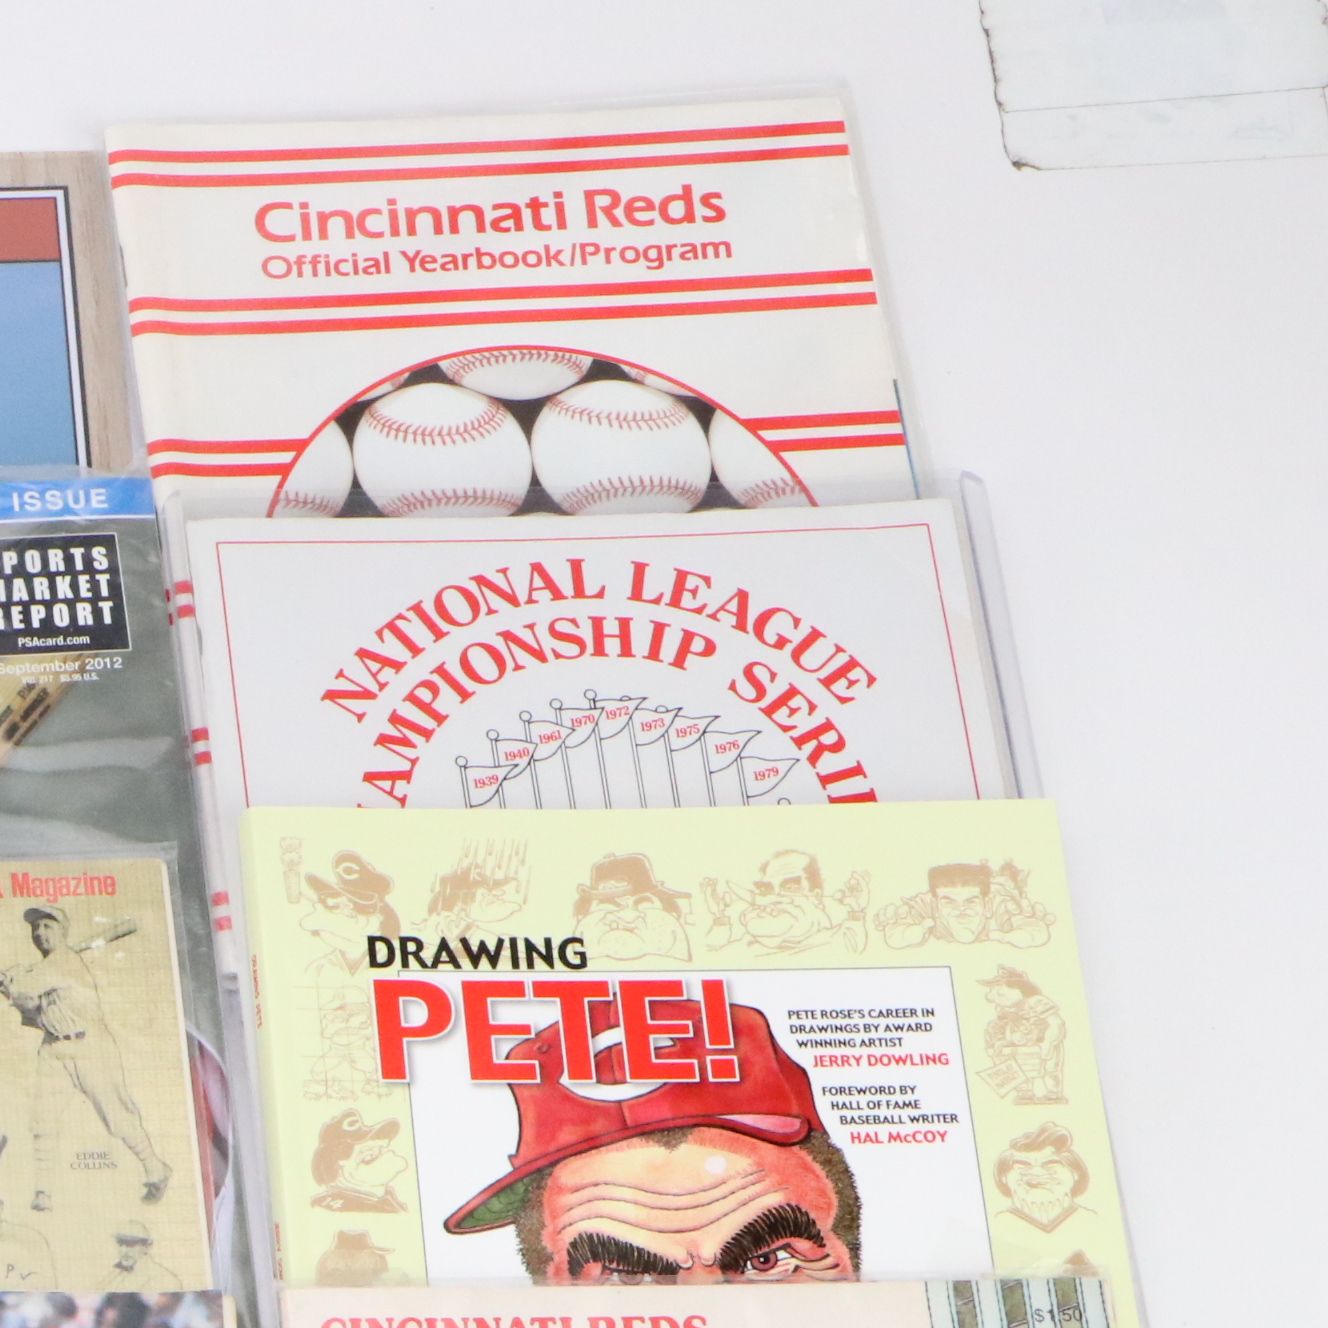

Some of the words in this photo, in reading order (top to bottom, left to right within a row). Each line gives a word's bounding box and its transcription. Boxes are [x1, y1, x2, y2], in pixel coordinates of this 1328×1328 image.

[253, 189, 569, 244] Cincinnati
[583, 183, 728, 230] Reds
[260, 249, 392, 281] Official
[399, 237, 735, 276] Yearbook/Program
[12, 488, 110, 512] ISSUE
[17, 634, 91, 648] PSAcard.com
[320, 557, 606, 722] NATIONAL
[628, 558, 878, 706] LEAGUE
[85, 656, 124, 670] 2012
[604, 705, 631, 721] 1972
[570, 713, 597, 730] 1970
[639, 717, 666, 733] 1973
[674, 723, 702, 740] 1975
[503, 746, 531, 763] 1940
[714, 739, 741, 756] 1976
[472, 774, 500, 790] 1939
[752, 766, 780, 783] 1979
[11, 871, 117, 904] Magazine
[367, 934, 588, 971] DRAWING
[787, 1009, 818, 1020] PETE
[820, 1008, 866, 1020] ROSE'S
[868, 1008, 918, 1019] CAREER
[372, 976, 742, 1085] PETE!
[789, 1023, 861, 1034] DRAWINGS
[883, 1022, 933, 1033] AWARD
[796, 1037, 857, 1049] WINNING
[859, 1037, 904, 1048] ARTIST
[813, 1054, 864, 1068] JERRY
[867, 1053, 950, 1067] DOWLING
[822, 1085, 897, 1096] FOREWORD
[830, 1100, 864, 1111] HALL
[885, 1099, 921, 1110] FAME
[839, 1114, 907, 1125] BASEBALL
[908, 1113, 960, 1124] WRITER
[850, 1131, 884, 1144] HAL
[887, 1130, 949, 1143] McCOY
